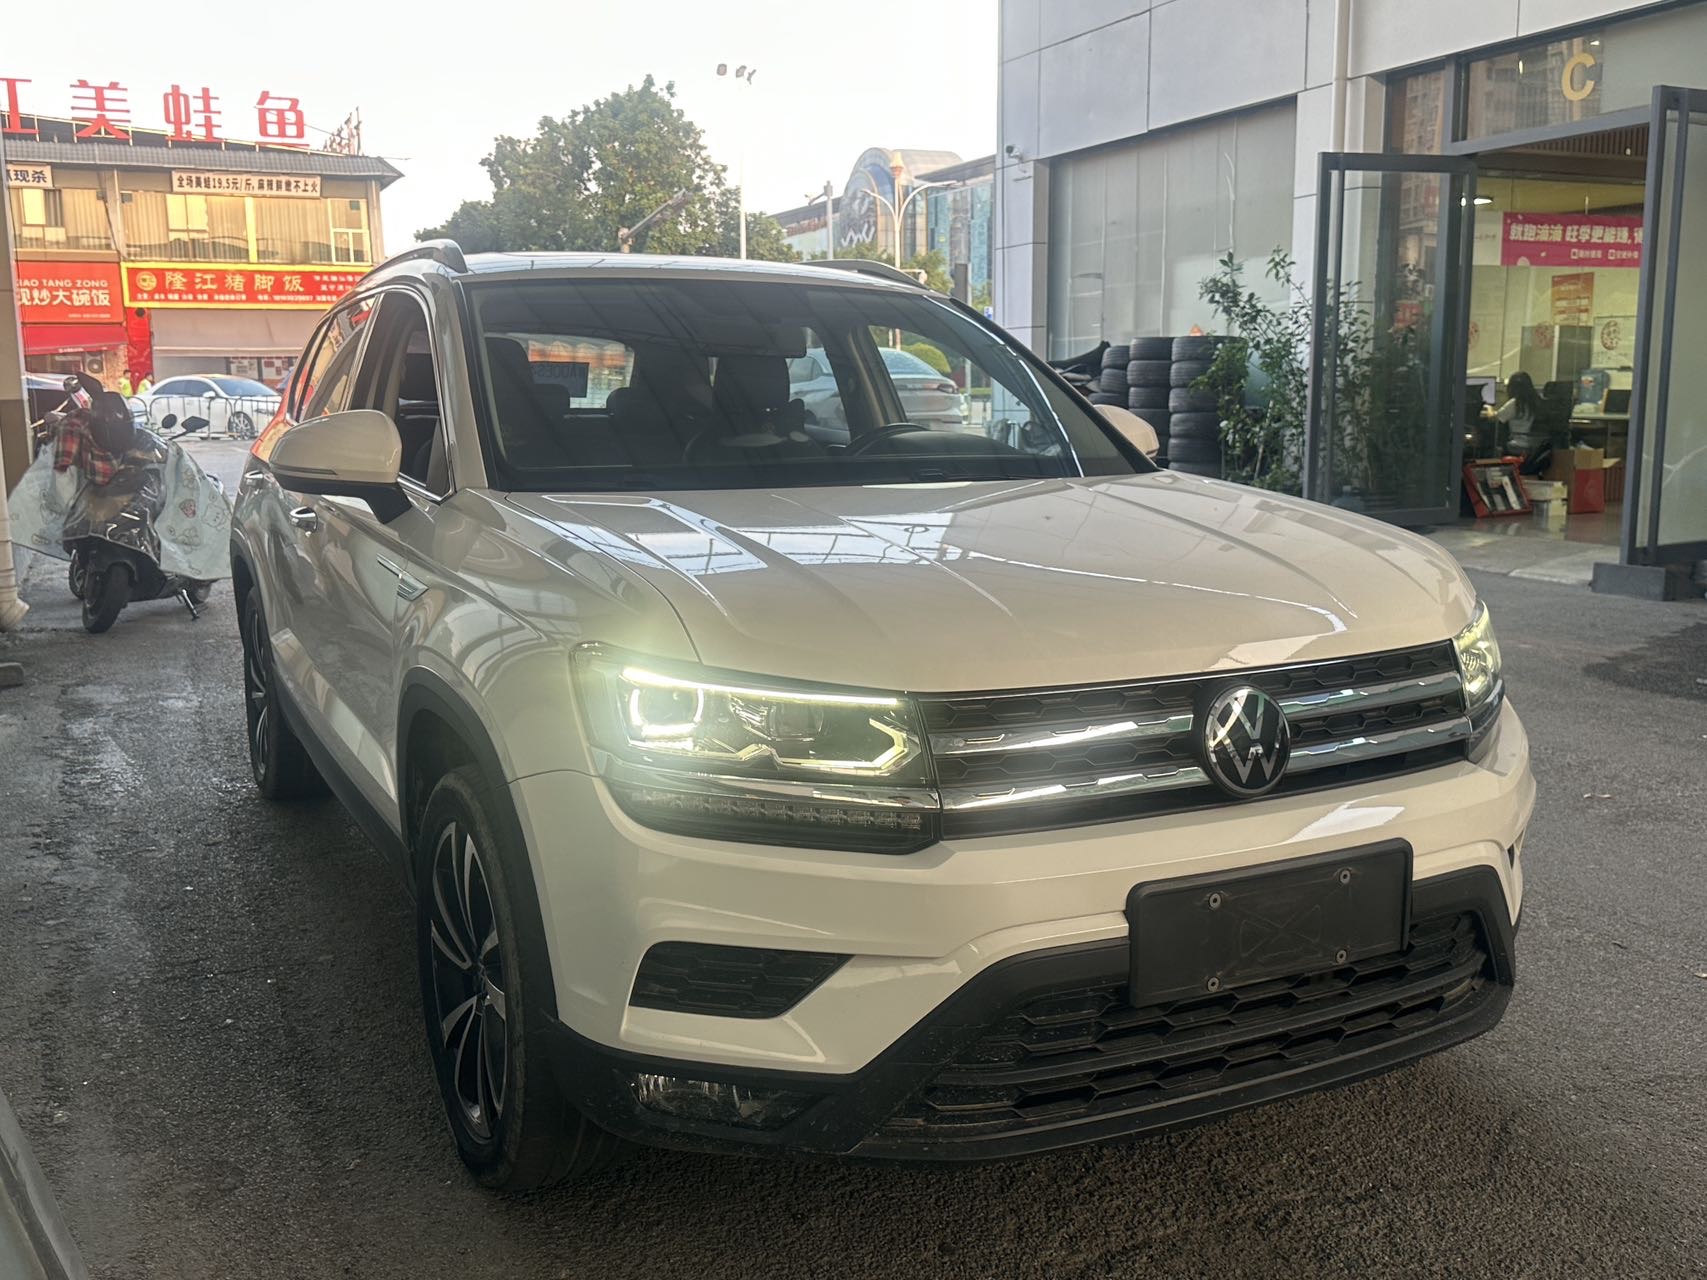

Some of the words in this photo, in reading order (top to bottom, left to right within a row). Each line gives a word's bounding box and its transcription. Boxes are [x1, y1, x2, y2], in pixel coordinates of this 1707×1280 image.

[1562, 53, 1595, 100] C
[16, 279, 39, 287] IAO
[42, 279, 72, 288] TANG
[76, 280, 108, 288] ZONG
[164, 271, 304, 292] 隆江猪脚饭
